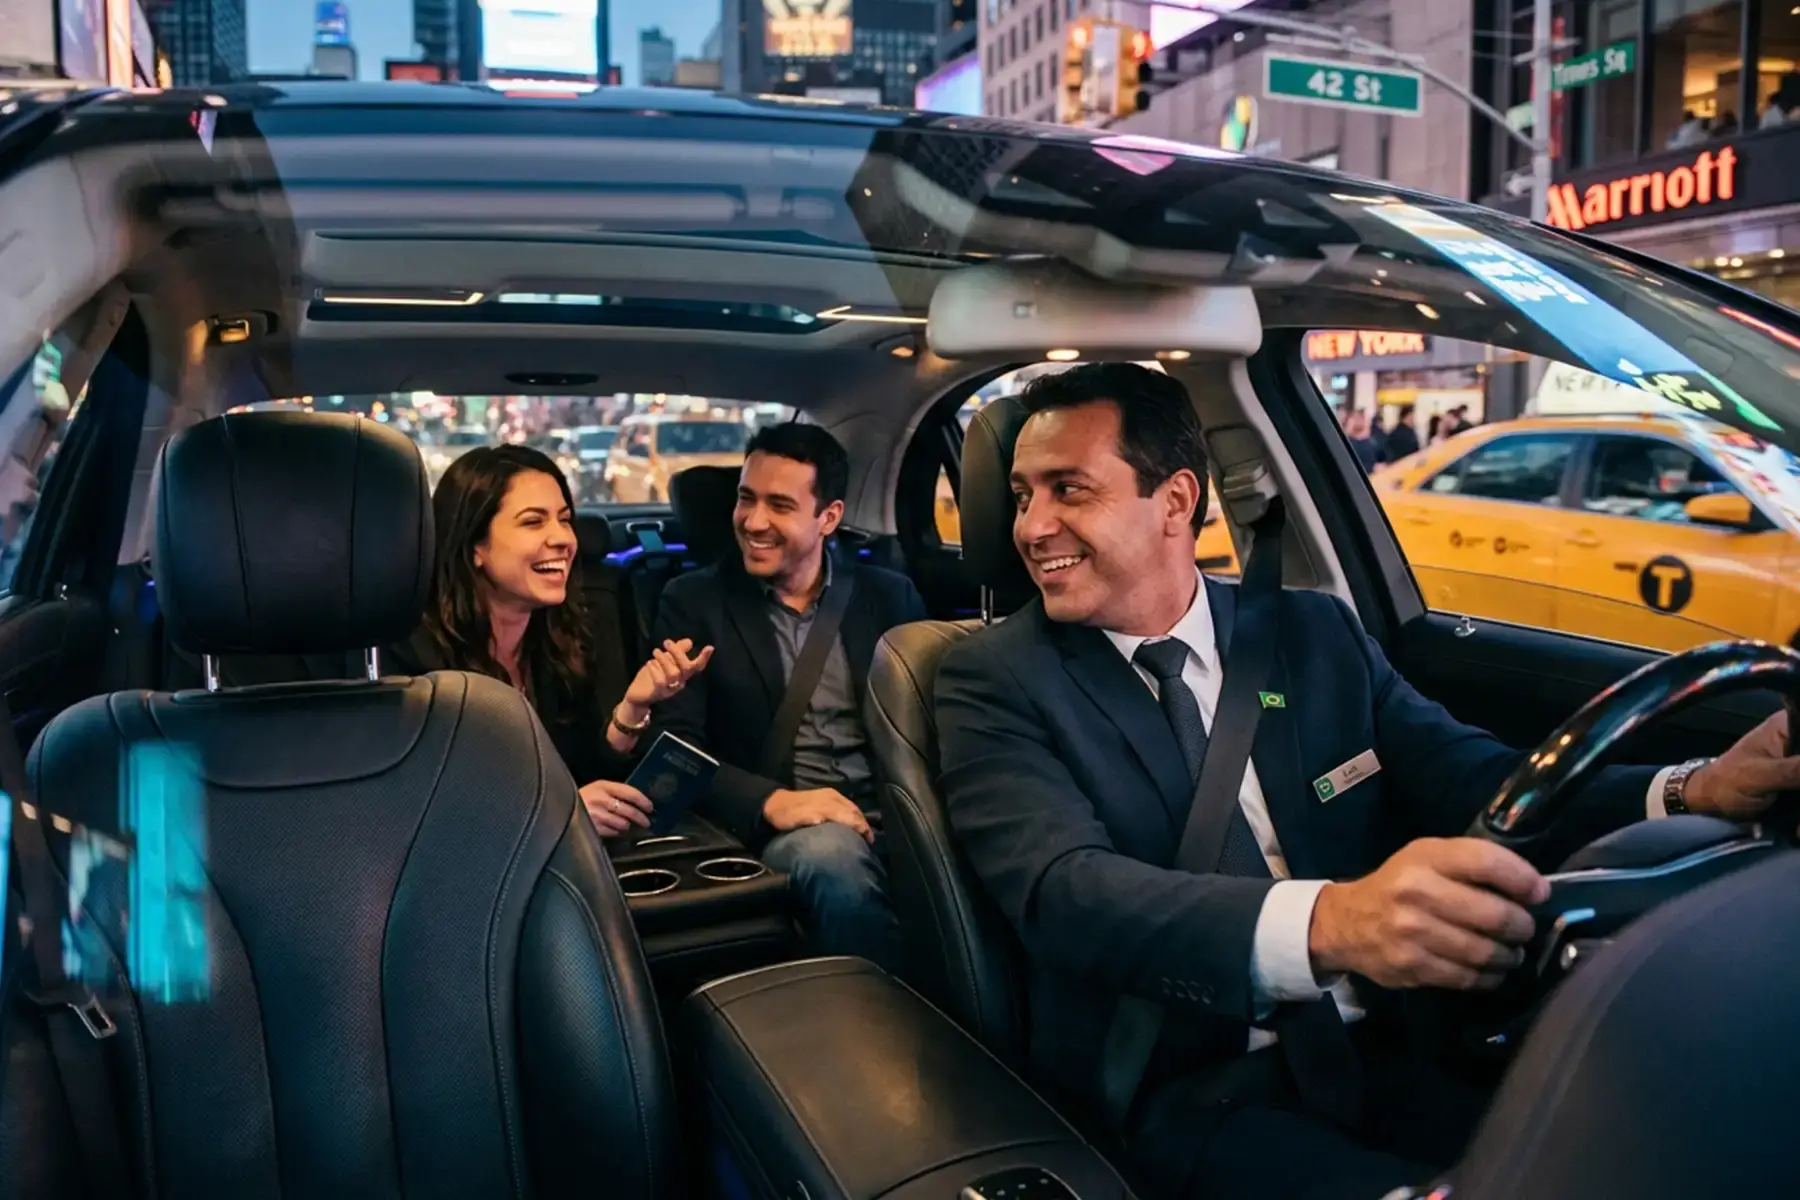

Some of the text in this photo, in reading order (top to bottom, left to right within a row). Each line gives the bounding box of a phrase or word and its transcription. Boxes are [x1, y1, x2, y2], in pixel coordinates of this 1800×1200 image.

[1603, 47, 1627, 75] Sq
[1307, 69, 1383, 103] 42 St
[1546, 145, 1737, 230] Marriott
[1306, 329, 1425, 360] NEW YORK
[1651, 565, 1684, 608] T
